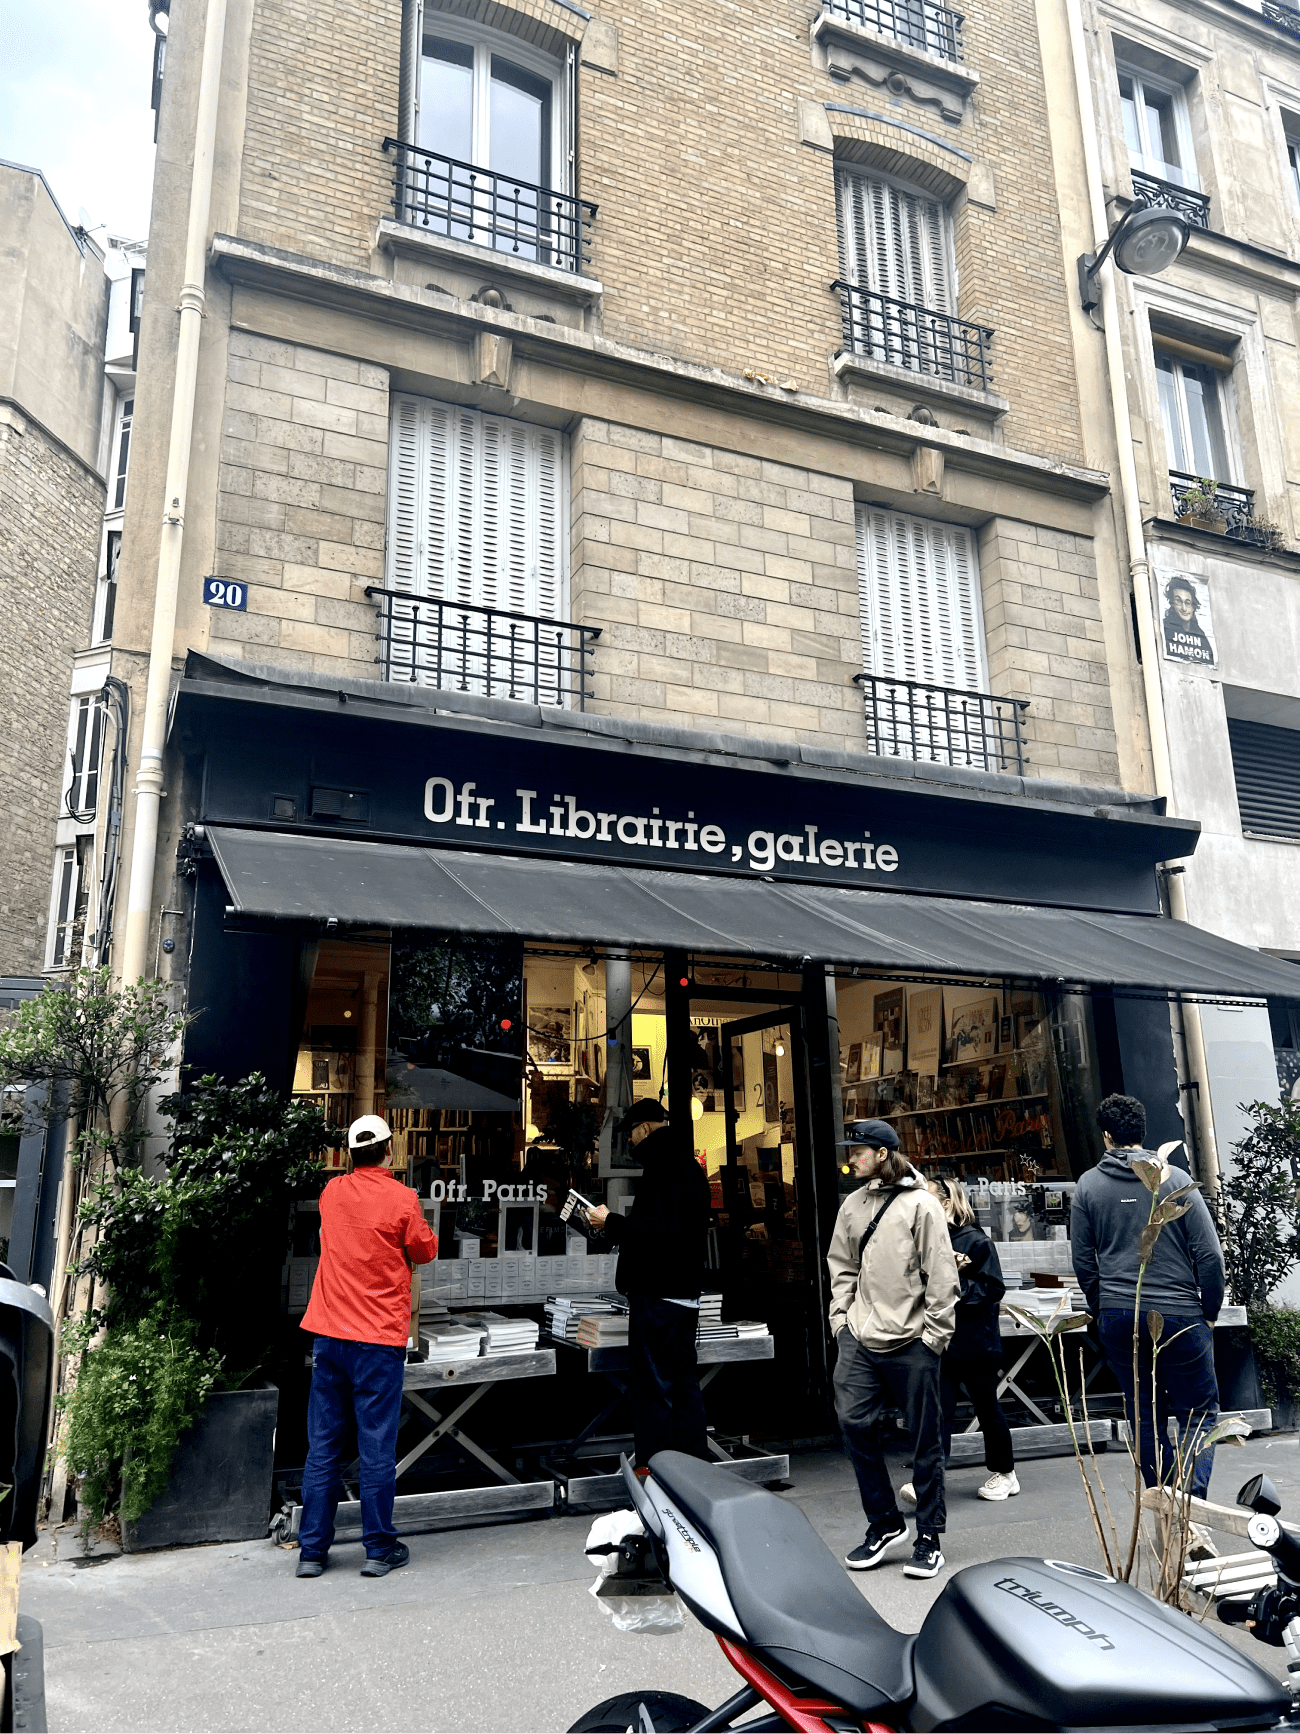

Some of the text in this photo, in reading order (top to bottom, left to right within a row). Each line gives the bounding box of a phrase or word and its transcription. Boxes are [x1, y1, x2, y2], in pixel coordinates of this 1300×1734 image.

[208, 581, 242, 607] 20
[1172, 631, 1202, 647] JOHN
[1169, 642, 1210, 661] HAMON
[424, 776, 505, 830] Ofr.
[747, 824, 899, 872] galerie
[430, 1179, 548, 1203] Ofr. Paris
[978, 1177, 1026, 1197] Paris
